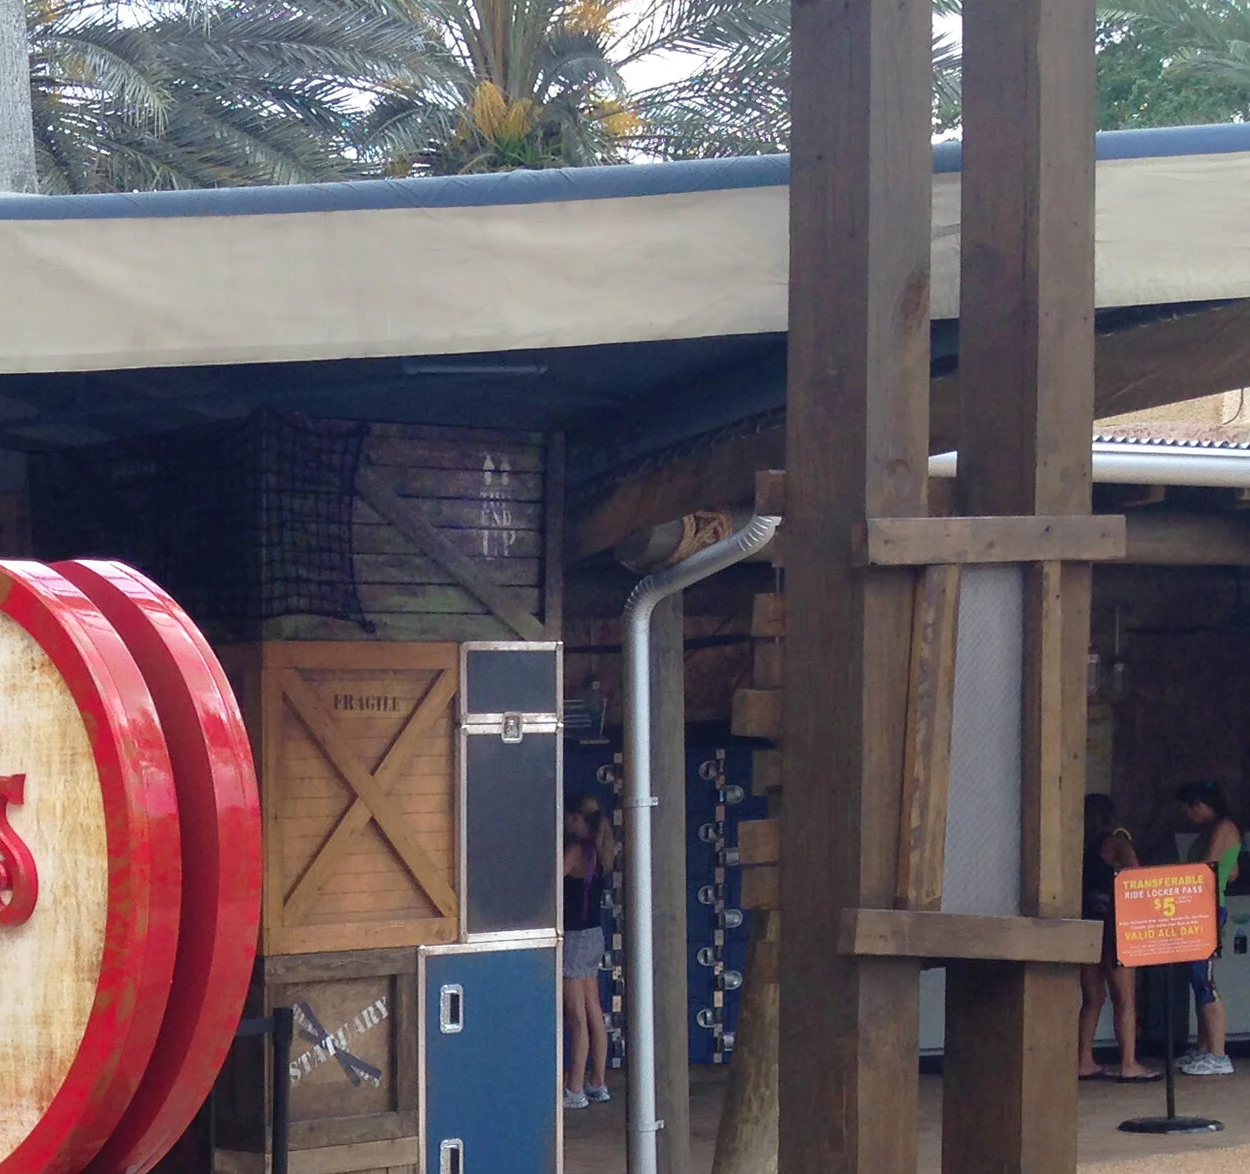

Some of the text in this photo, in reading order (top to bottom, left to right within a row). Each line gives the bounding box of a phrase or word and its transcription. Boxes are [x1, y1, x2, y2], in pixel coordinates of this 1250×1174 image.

[334, 694, 401, 712] FRAGILE
[1123, 874, 1205, 890] TRANSFERABLE
[1124, 890, 1145, 899] RIDE
[1146, 887, 1180, 898] LOCKER
[1182, 885, 1204, 894] PASS
[1153, 896, 1176, 917] $5
[1124, 929, 1155, 941] VALID
[1158, 927, 1177, 938] ALL
